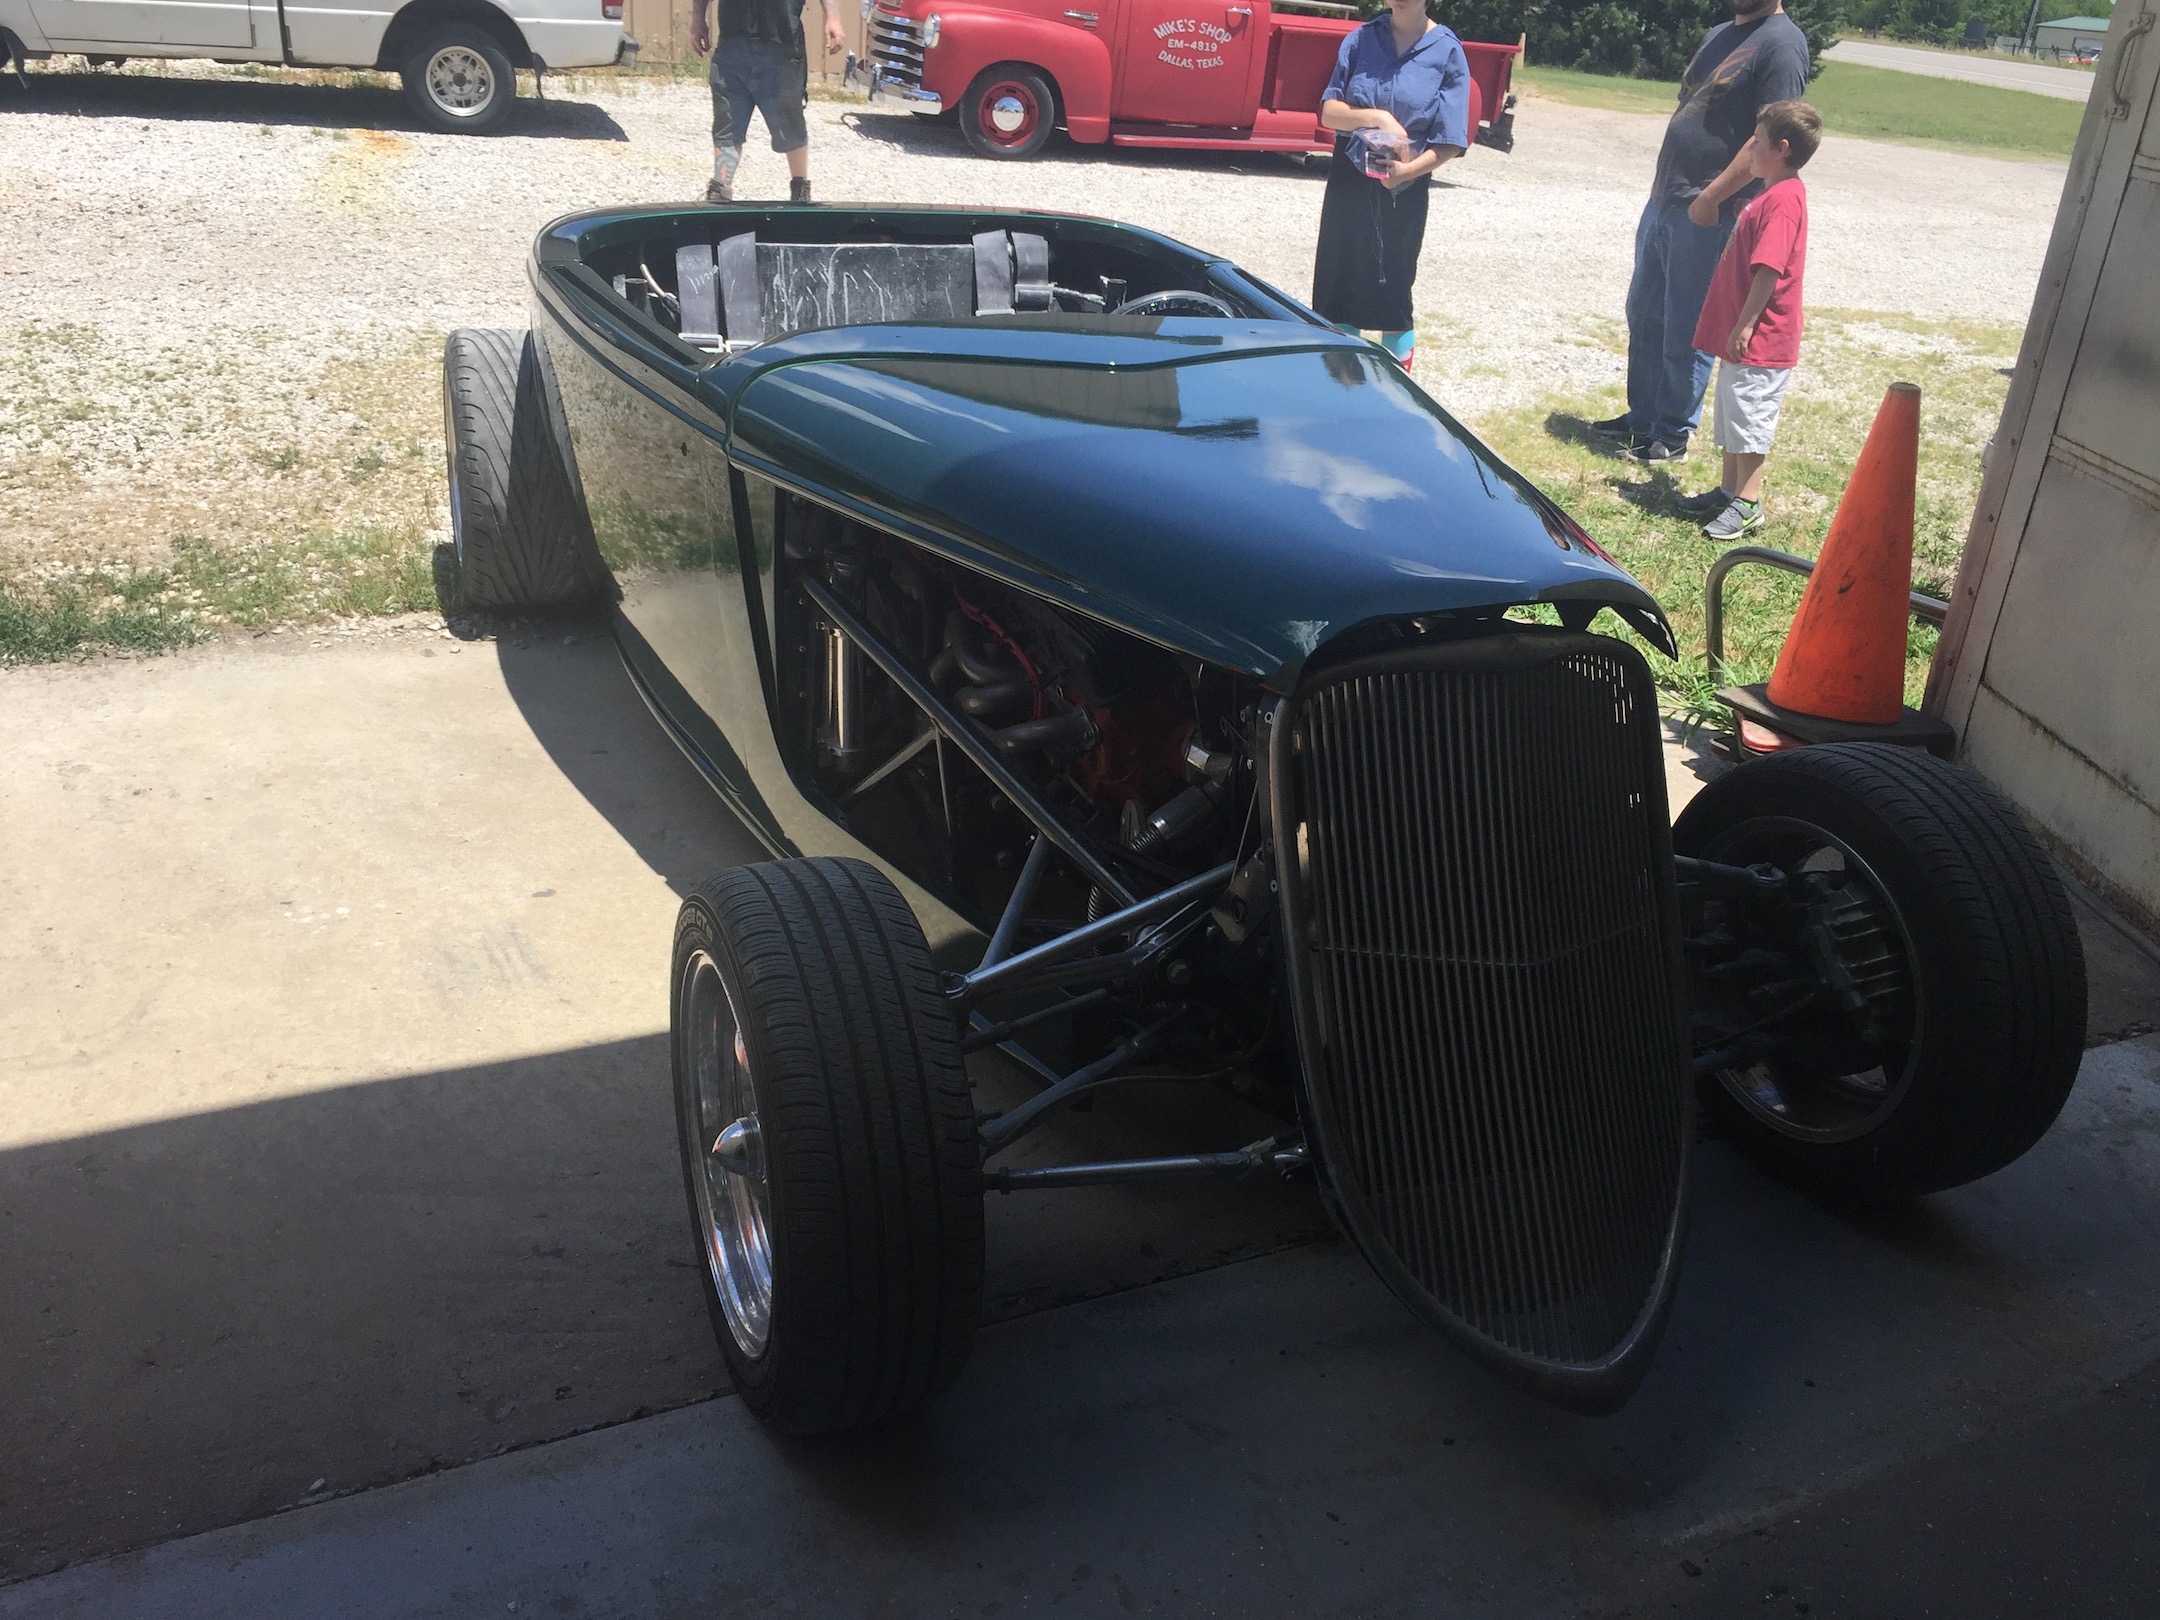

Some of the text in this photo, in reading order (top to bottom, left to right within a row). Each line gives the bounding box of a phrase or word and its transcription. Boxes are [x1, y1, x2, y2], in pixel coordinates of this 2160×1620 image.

[1153, 19, 1232, 43] MIKE'S SHOP
[1167, 39, 1218, 52] EM-4819
[1158, 50, 1224, 69] DALLAS, TEXAS
